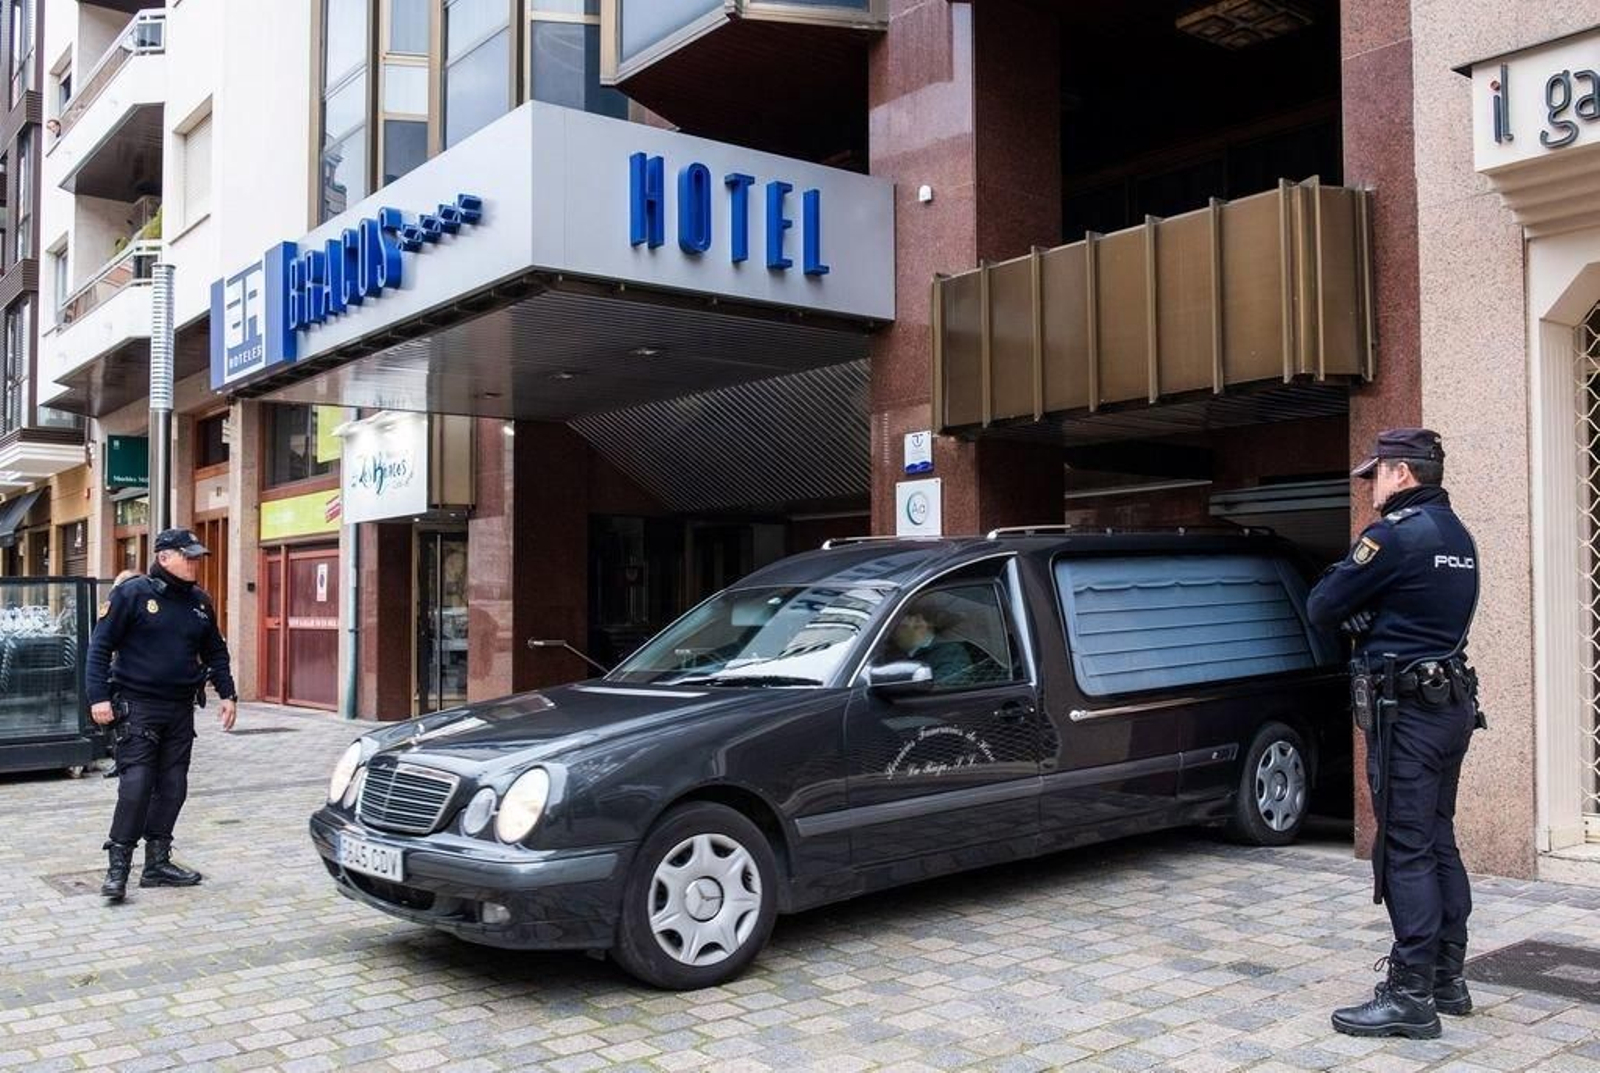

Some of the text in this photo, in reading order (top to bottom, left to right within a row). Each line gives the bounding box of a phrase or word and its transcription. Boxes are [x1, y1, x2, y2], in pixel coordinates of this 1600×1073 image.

[289, 206, 402, 330] BRACOS
[630, 152, 830, 276] HOTEL
[229, 344, 263, 369] HOTELES
